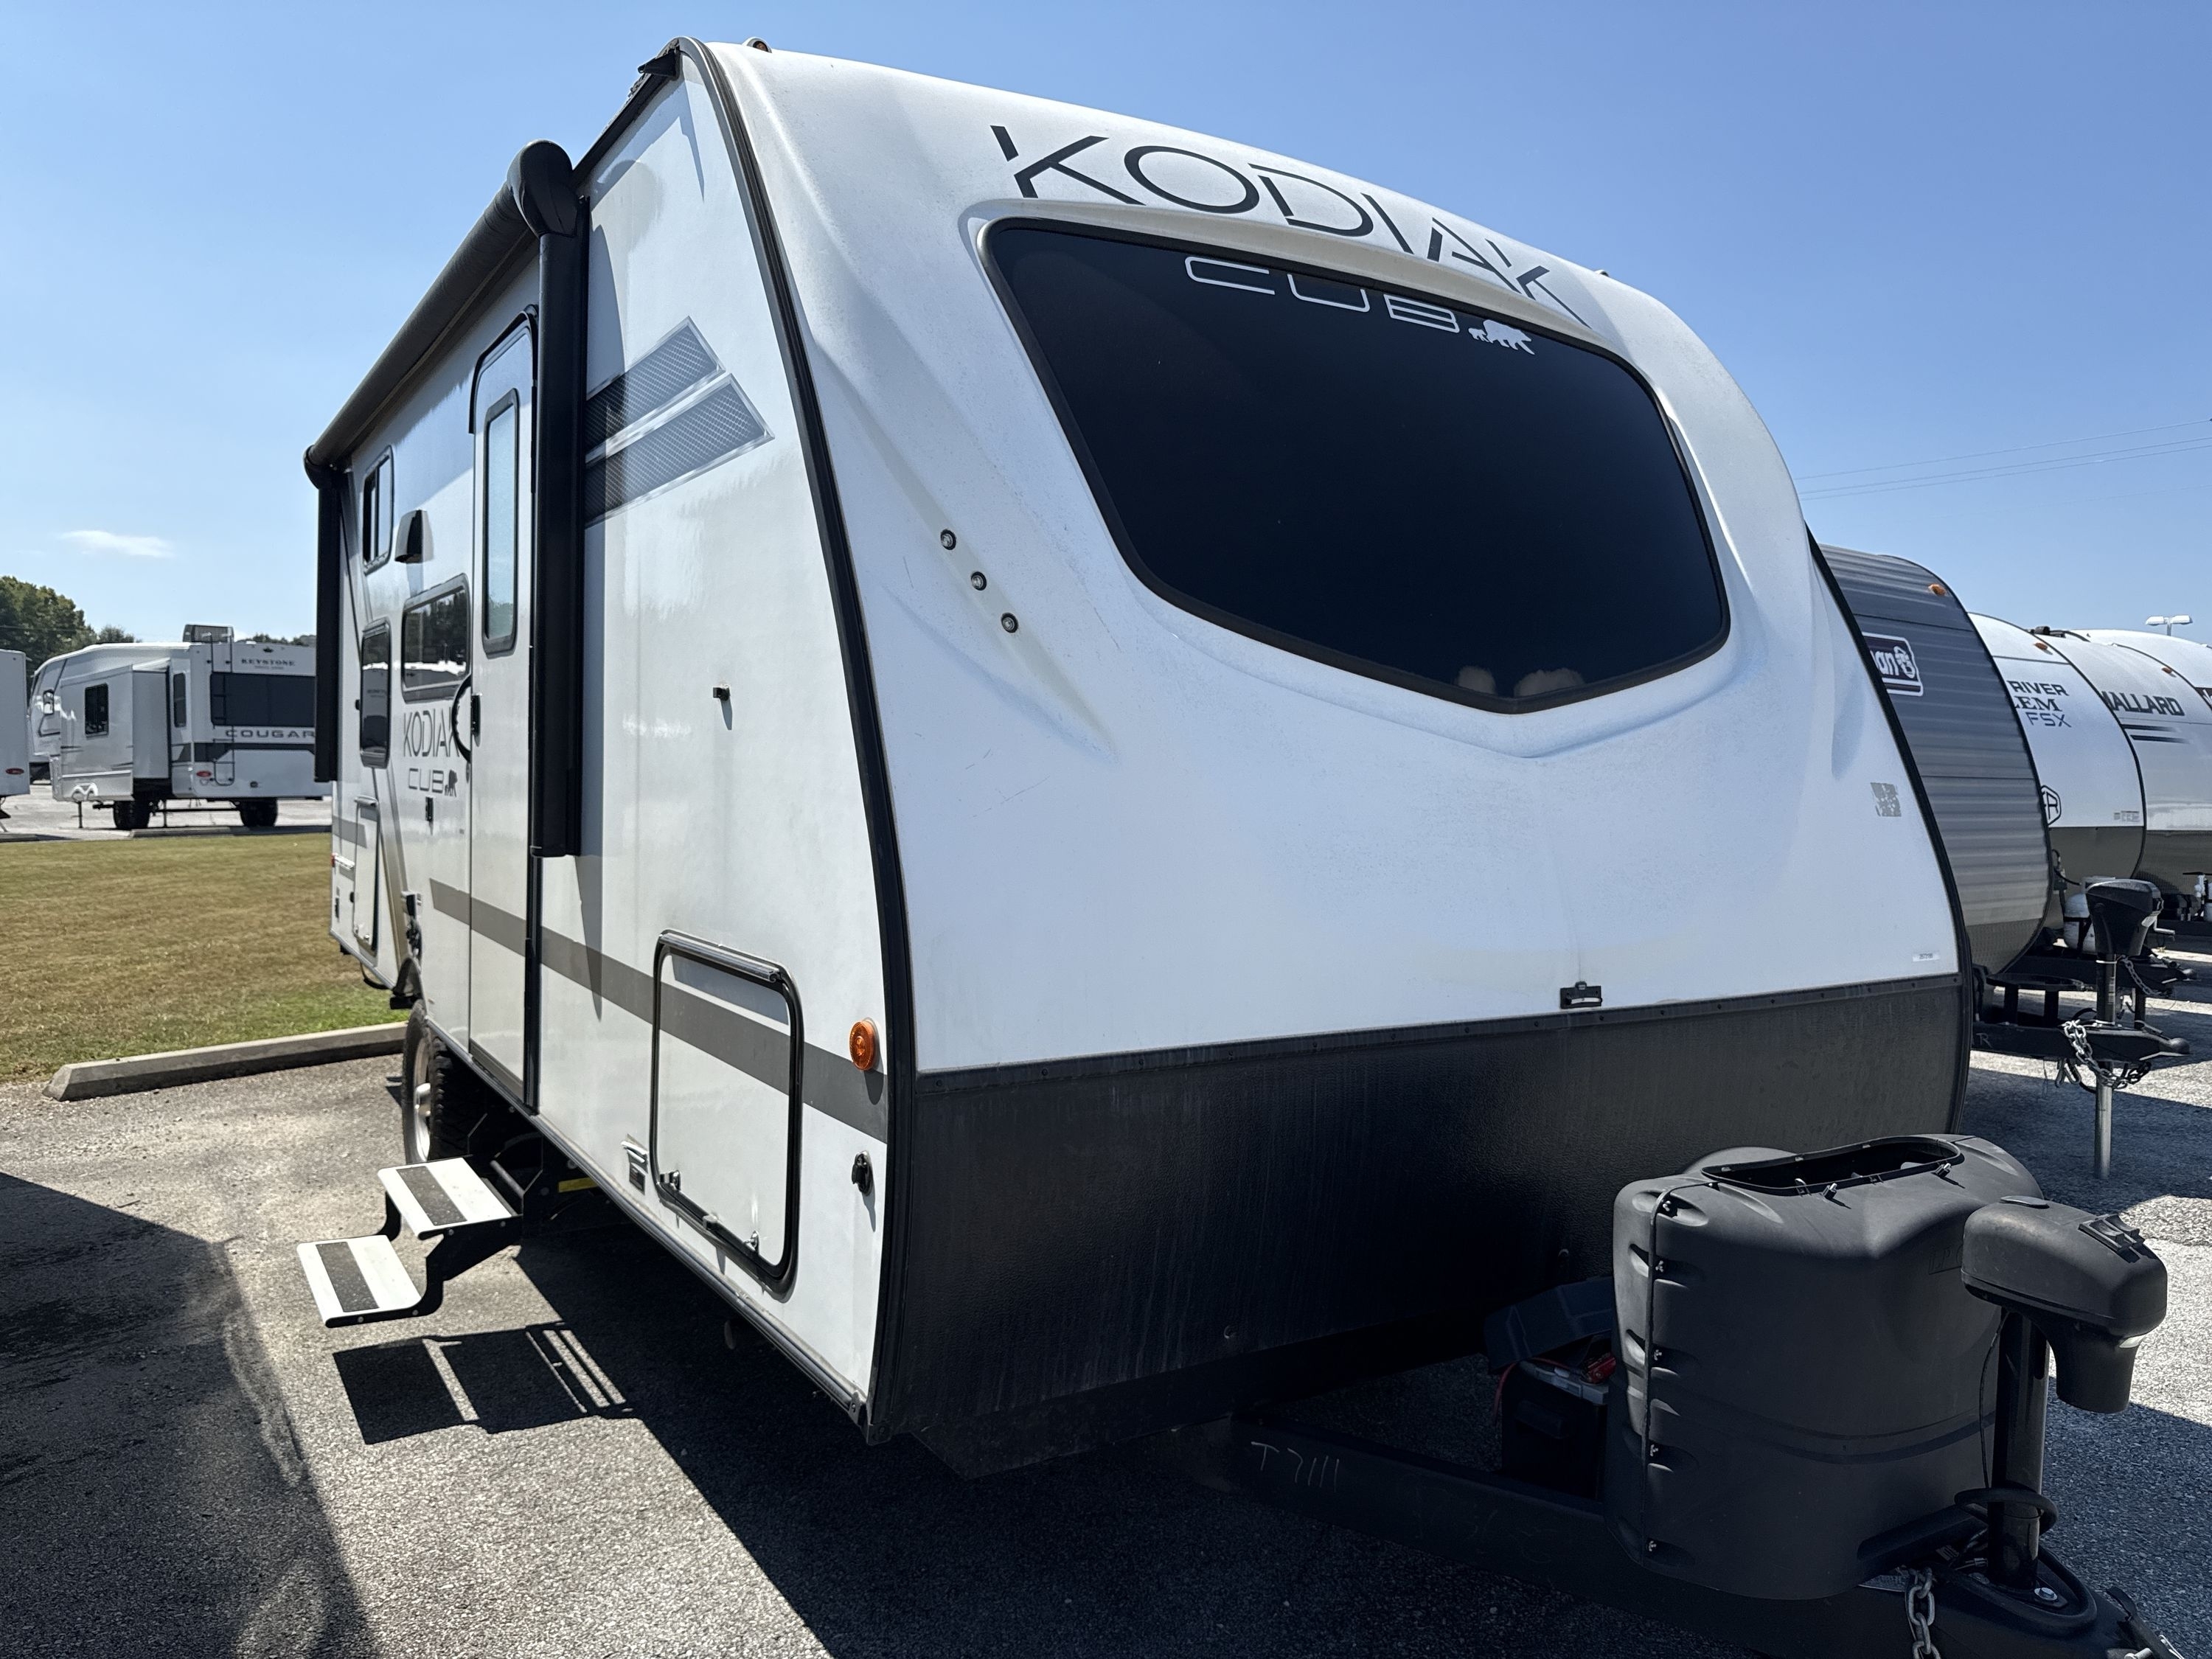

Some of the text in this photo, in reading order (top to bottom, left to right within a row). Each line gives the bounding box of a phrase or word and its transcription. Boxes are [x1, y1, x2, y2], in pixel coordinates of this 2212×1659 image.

[990, 125, 1590, 328] KODIAK
[1184, 255, 1461, 335] CUB
[241, 658, 296, 667] KEYSTONE
[2006, 680, 2070, 697] RIVER
[2025, 712, 2072, 728] FSX
[225, 728, 316, 739] COUGAR
[408, 768, 445, 794] CUB
